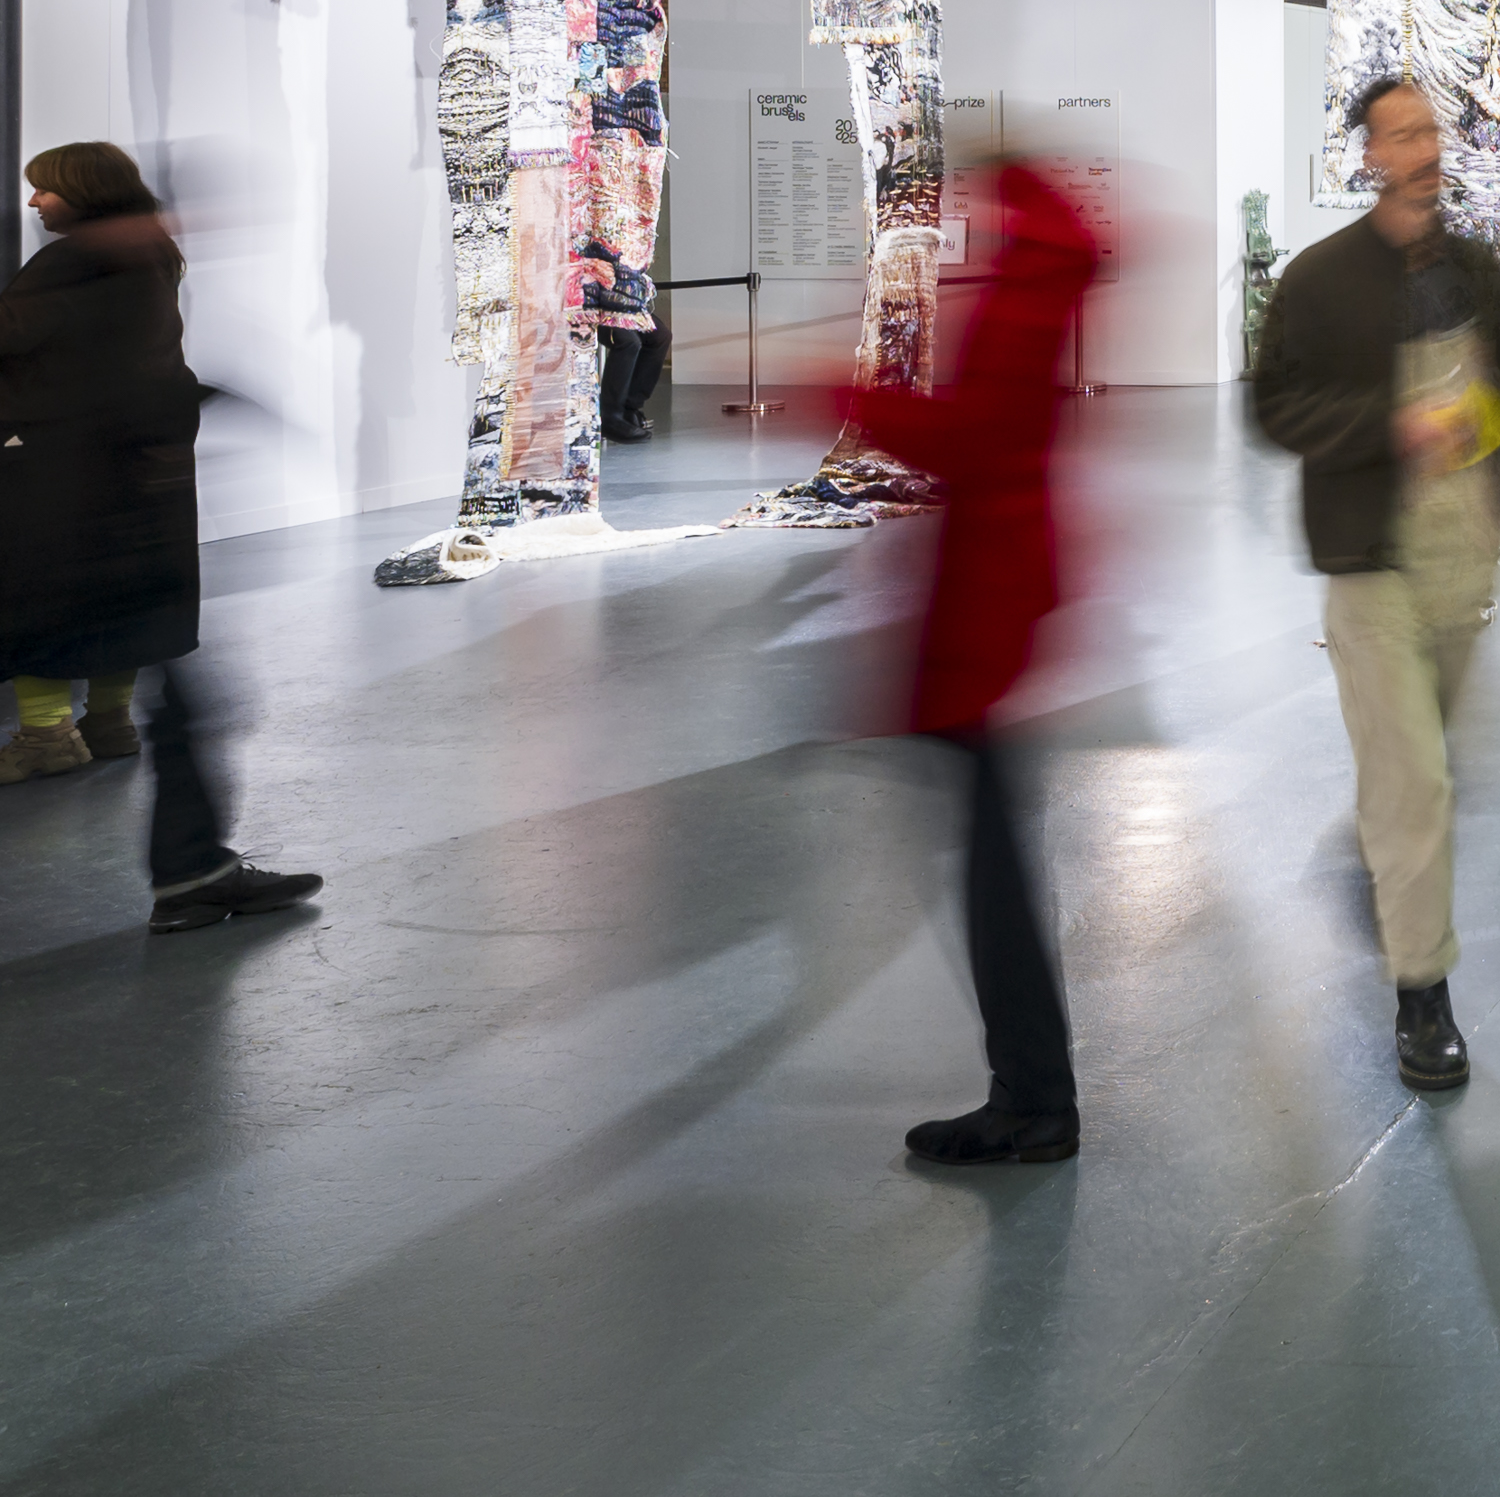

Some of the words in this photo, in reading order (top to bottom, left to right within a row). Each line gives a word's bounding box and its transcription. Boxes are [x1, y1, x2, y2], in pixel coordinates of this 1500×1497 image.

[757, 94, 807, 104] ceramic
[954, 96, 985, 110] prize
[1058, 96, 1112, 110] partners
[761, 103, 805, 121] brussels
